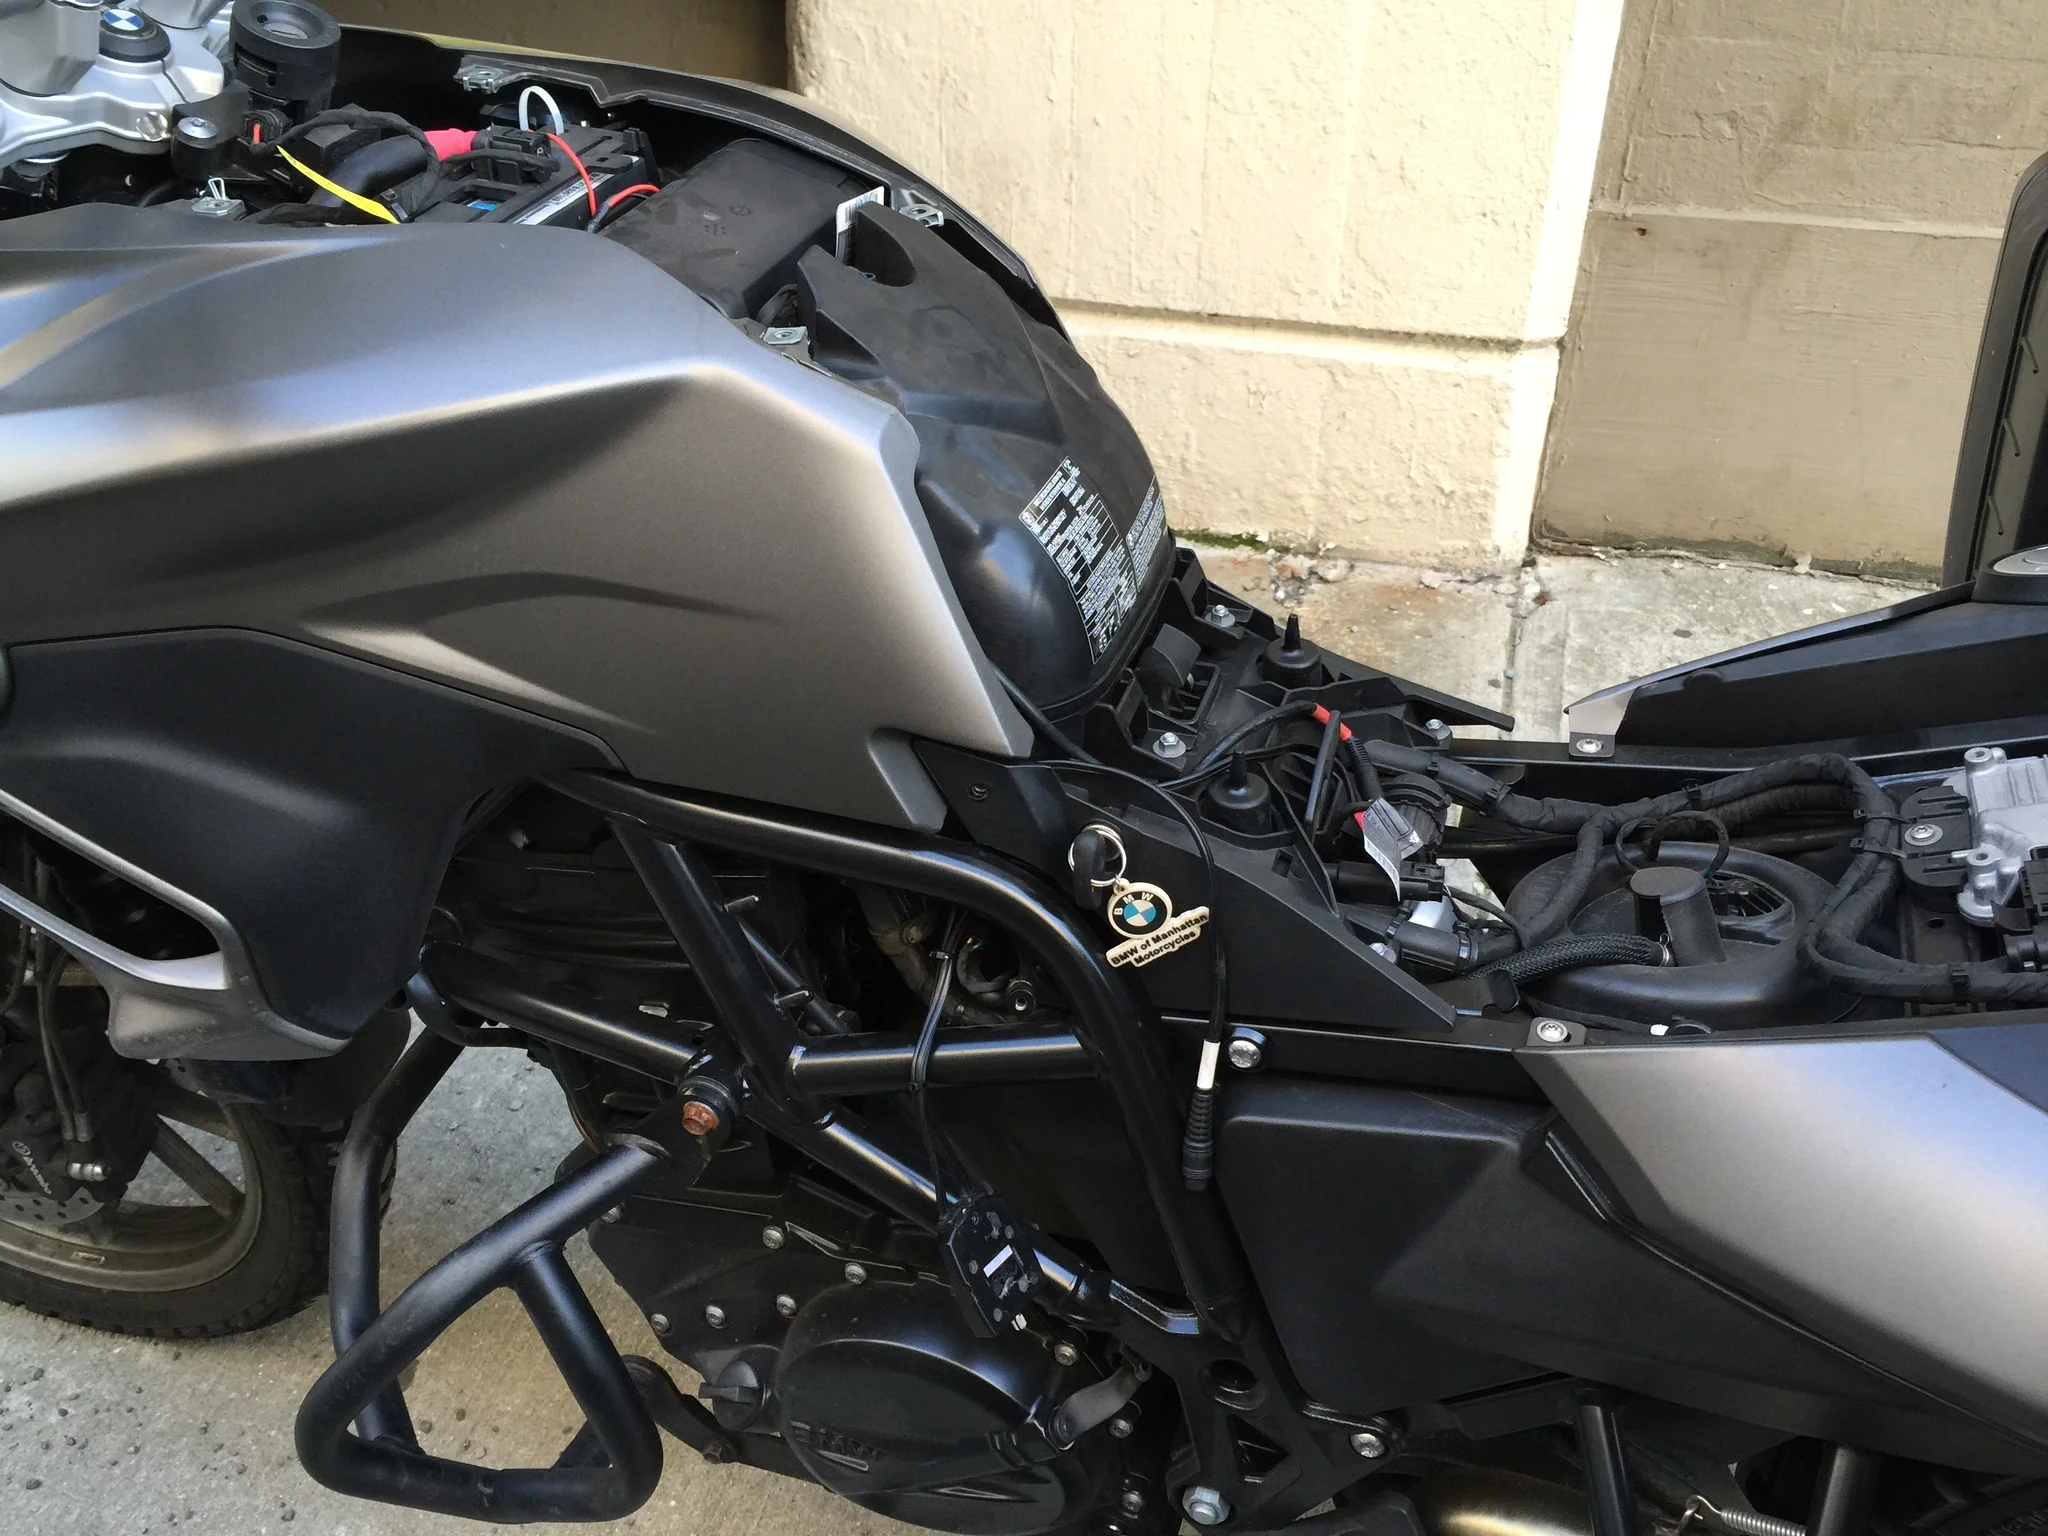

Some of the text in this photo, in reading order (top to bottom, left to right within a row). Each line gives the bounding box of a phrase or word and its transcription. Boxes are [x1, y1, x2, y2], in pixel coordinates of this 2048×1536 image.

[1111, 914, 1208, 965] BMW of Manhattan
[1133, 931, 1196, 965] Motorcycles
